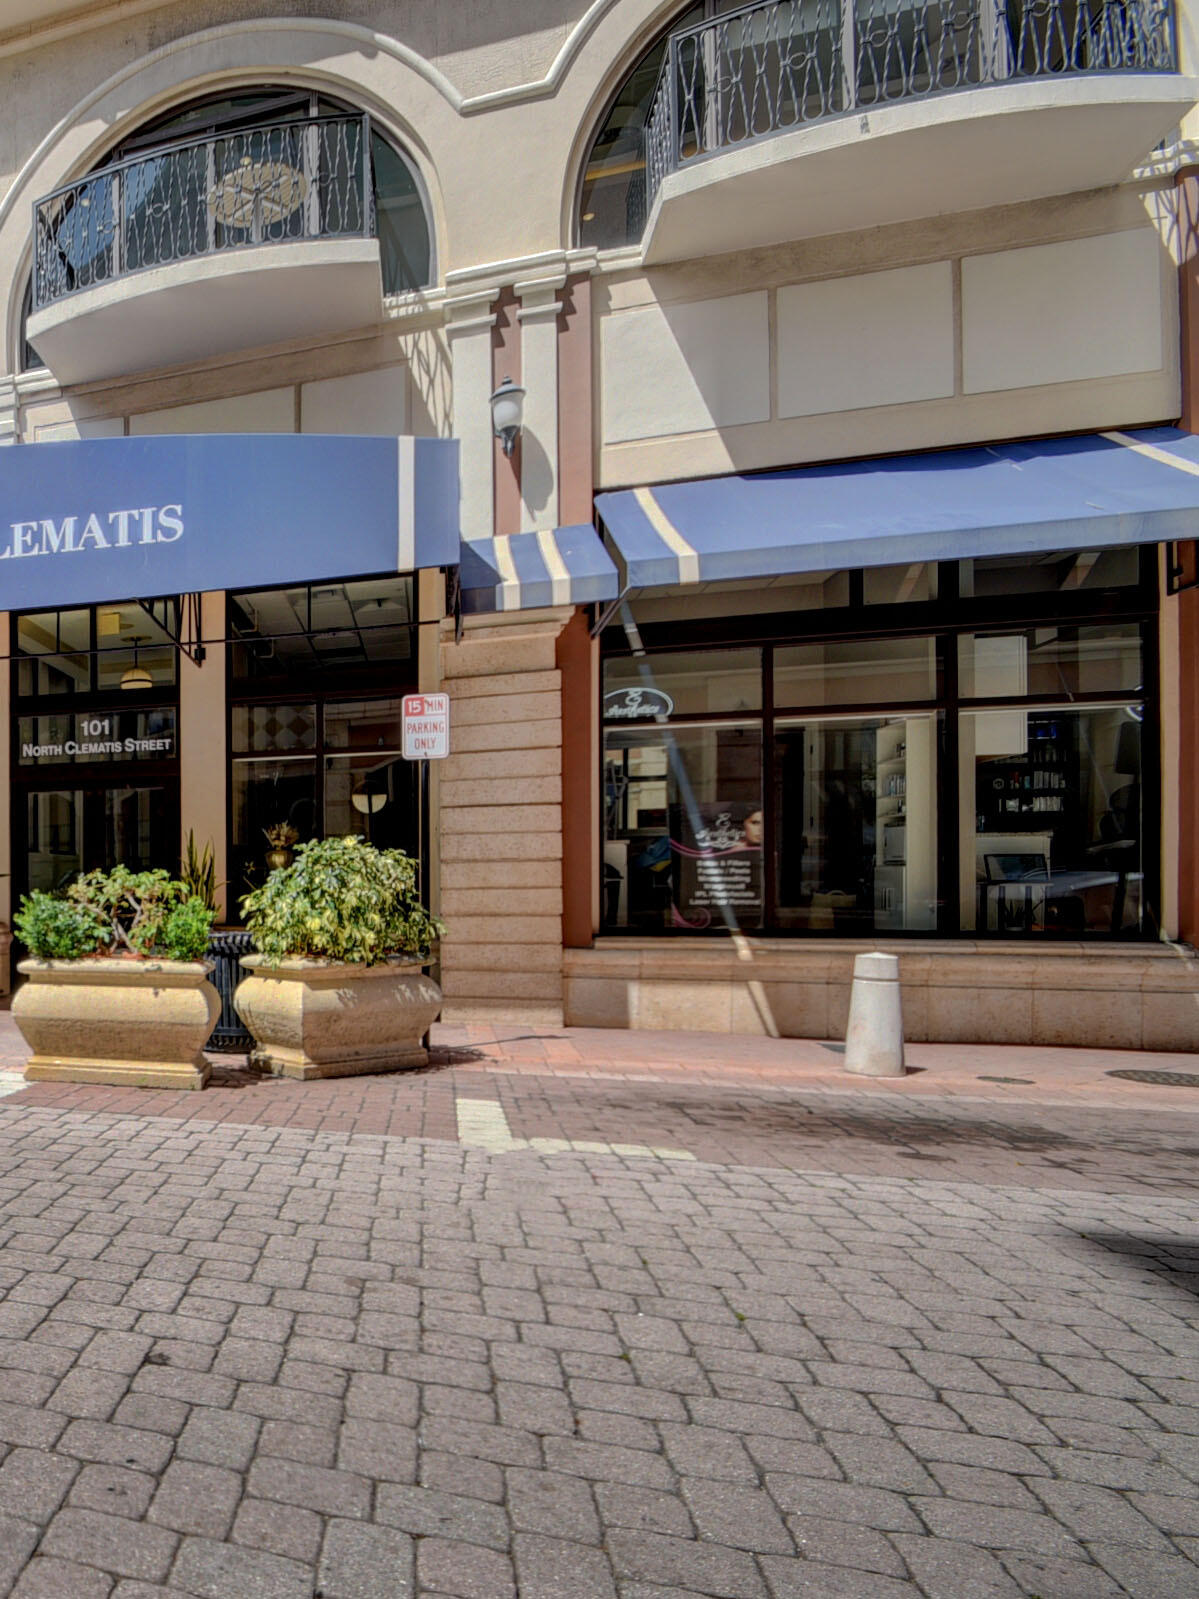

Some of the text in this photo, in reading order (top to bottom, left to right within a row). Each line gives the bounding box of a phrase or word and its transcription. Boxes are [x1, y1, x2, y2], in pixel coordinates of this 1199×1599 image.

[408, 699, 444, 713] 15 MIN
[81, 719, 110, 736] 101
[407, 721, 445, 734] PARKING
[22, 738, 172, 758] NORTH CLEMATIS STREET
[414, 737, 437, 750] ONLY
